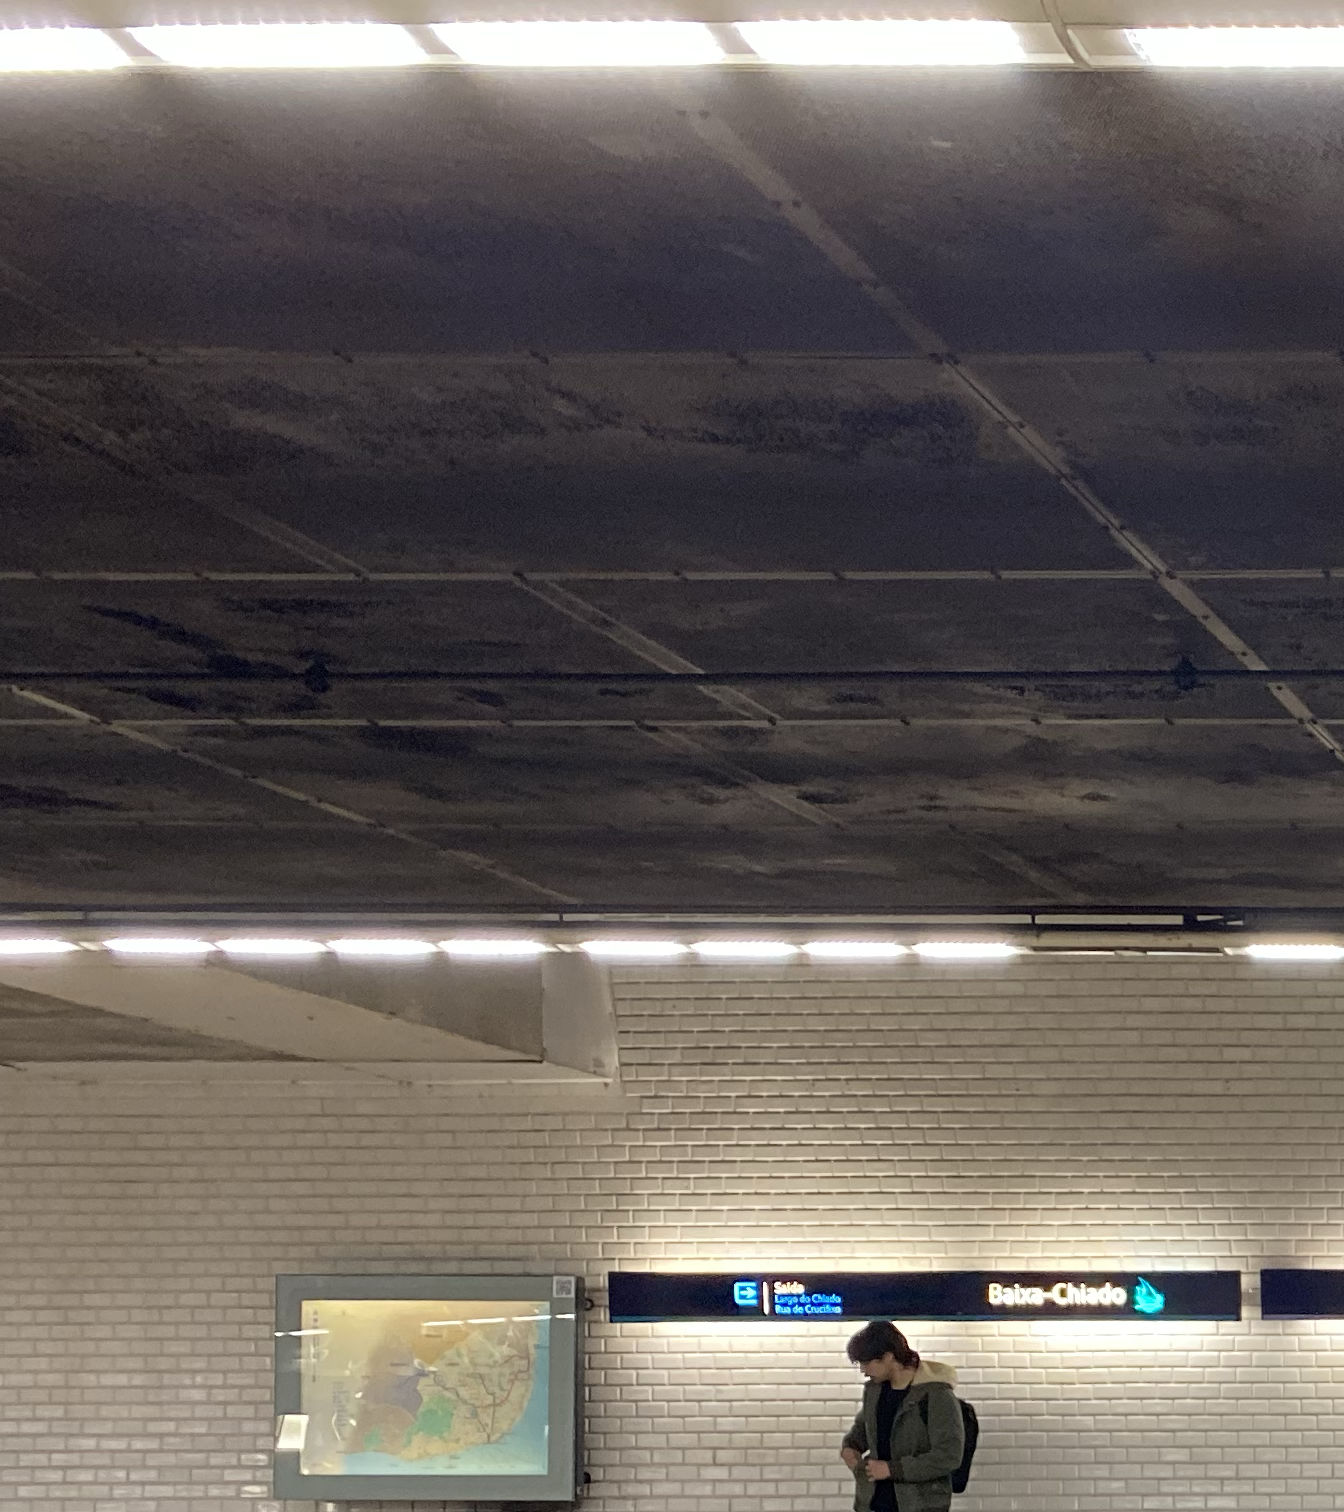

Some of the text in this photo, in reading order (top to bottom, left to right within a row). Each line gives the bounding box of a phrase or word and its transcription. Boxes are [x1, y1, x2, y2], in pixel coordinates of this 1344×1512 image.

[988, 1282, 1127, 1305] Baixa-Chiado
[775, 1294, 841, 1305] Largo do Chiado
[775, 1304, 791, 1314] Rua
